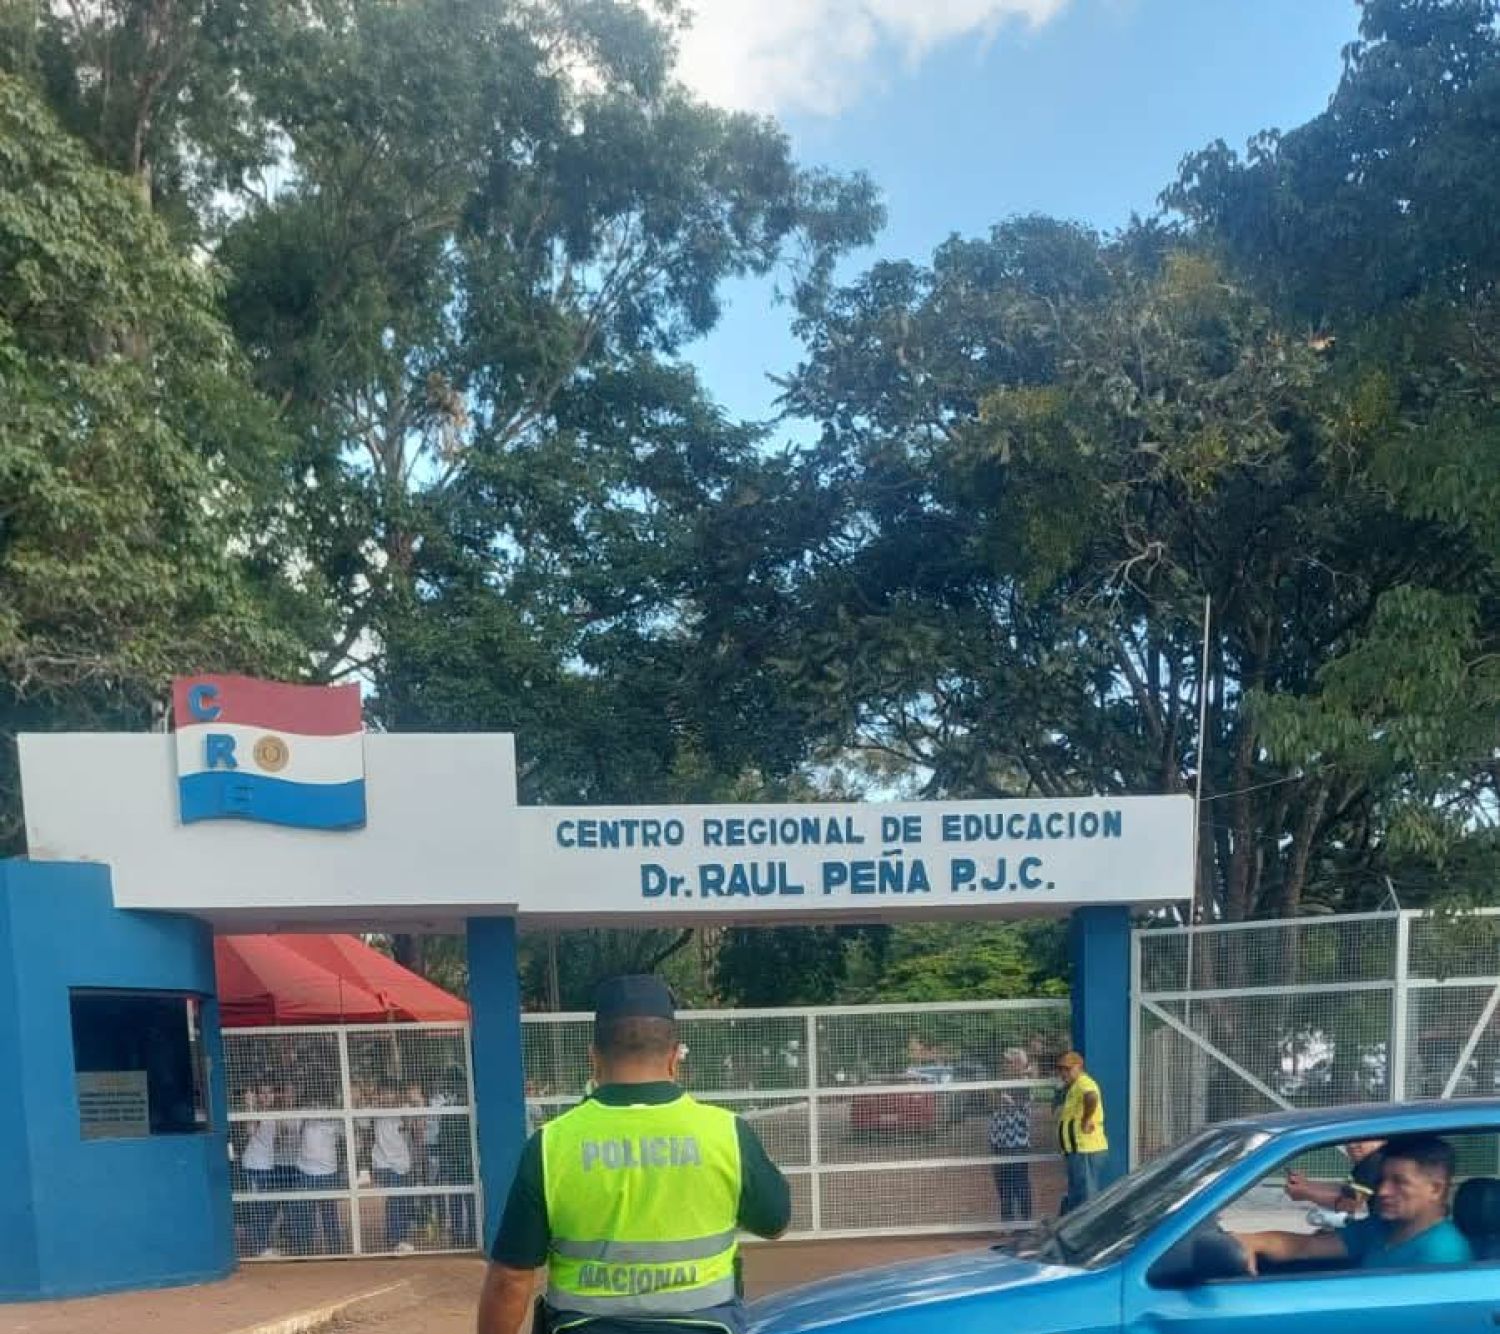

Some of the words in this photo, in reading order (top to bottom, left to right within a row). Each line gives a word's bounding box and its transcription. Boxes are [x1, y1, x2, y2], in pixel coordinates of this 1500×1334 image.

[188, 683, 221, 721] C
[206, 733, 238, 769] R
[556, 819, 685, 848] CENTRO
[703, 816, 865, 846] REGIONAL
[882, 815, 922, 843] DE
[942, 810, 1122, 842] EDUCACION
[640, 863, 693, 897] Dr.
[699, 861, 804, 897] RAUL
[822, 848, 931, 895] PEÑA
[950, 857, 1056, 892] P.J.C.
[581, 1136, 702, 1173] POLICIA
